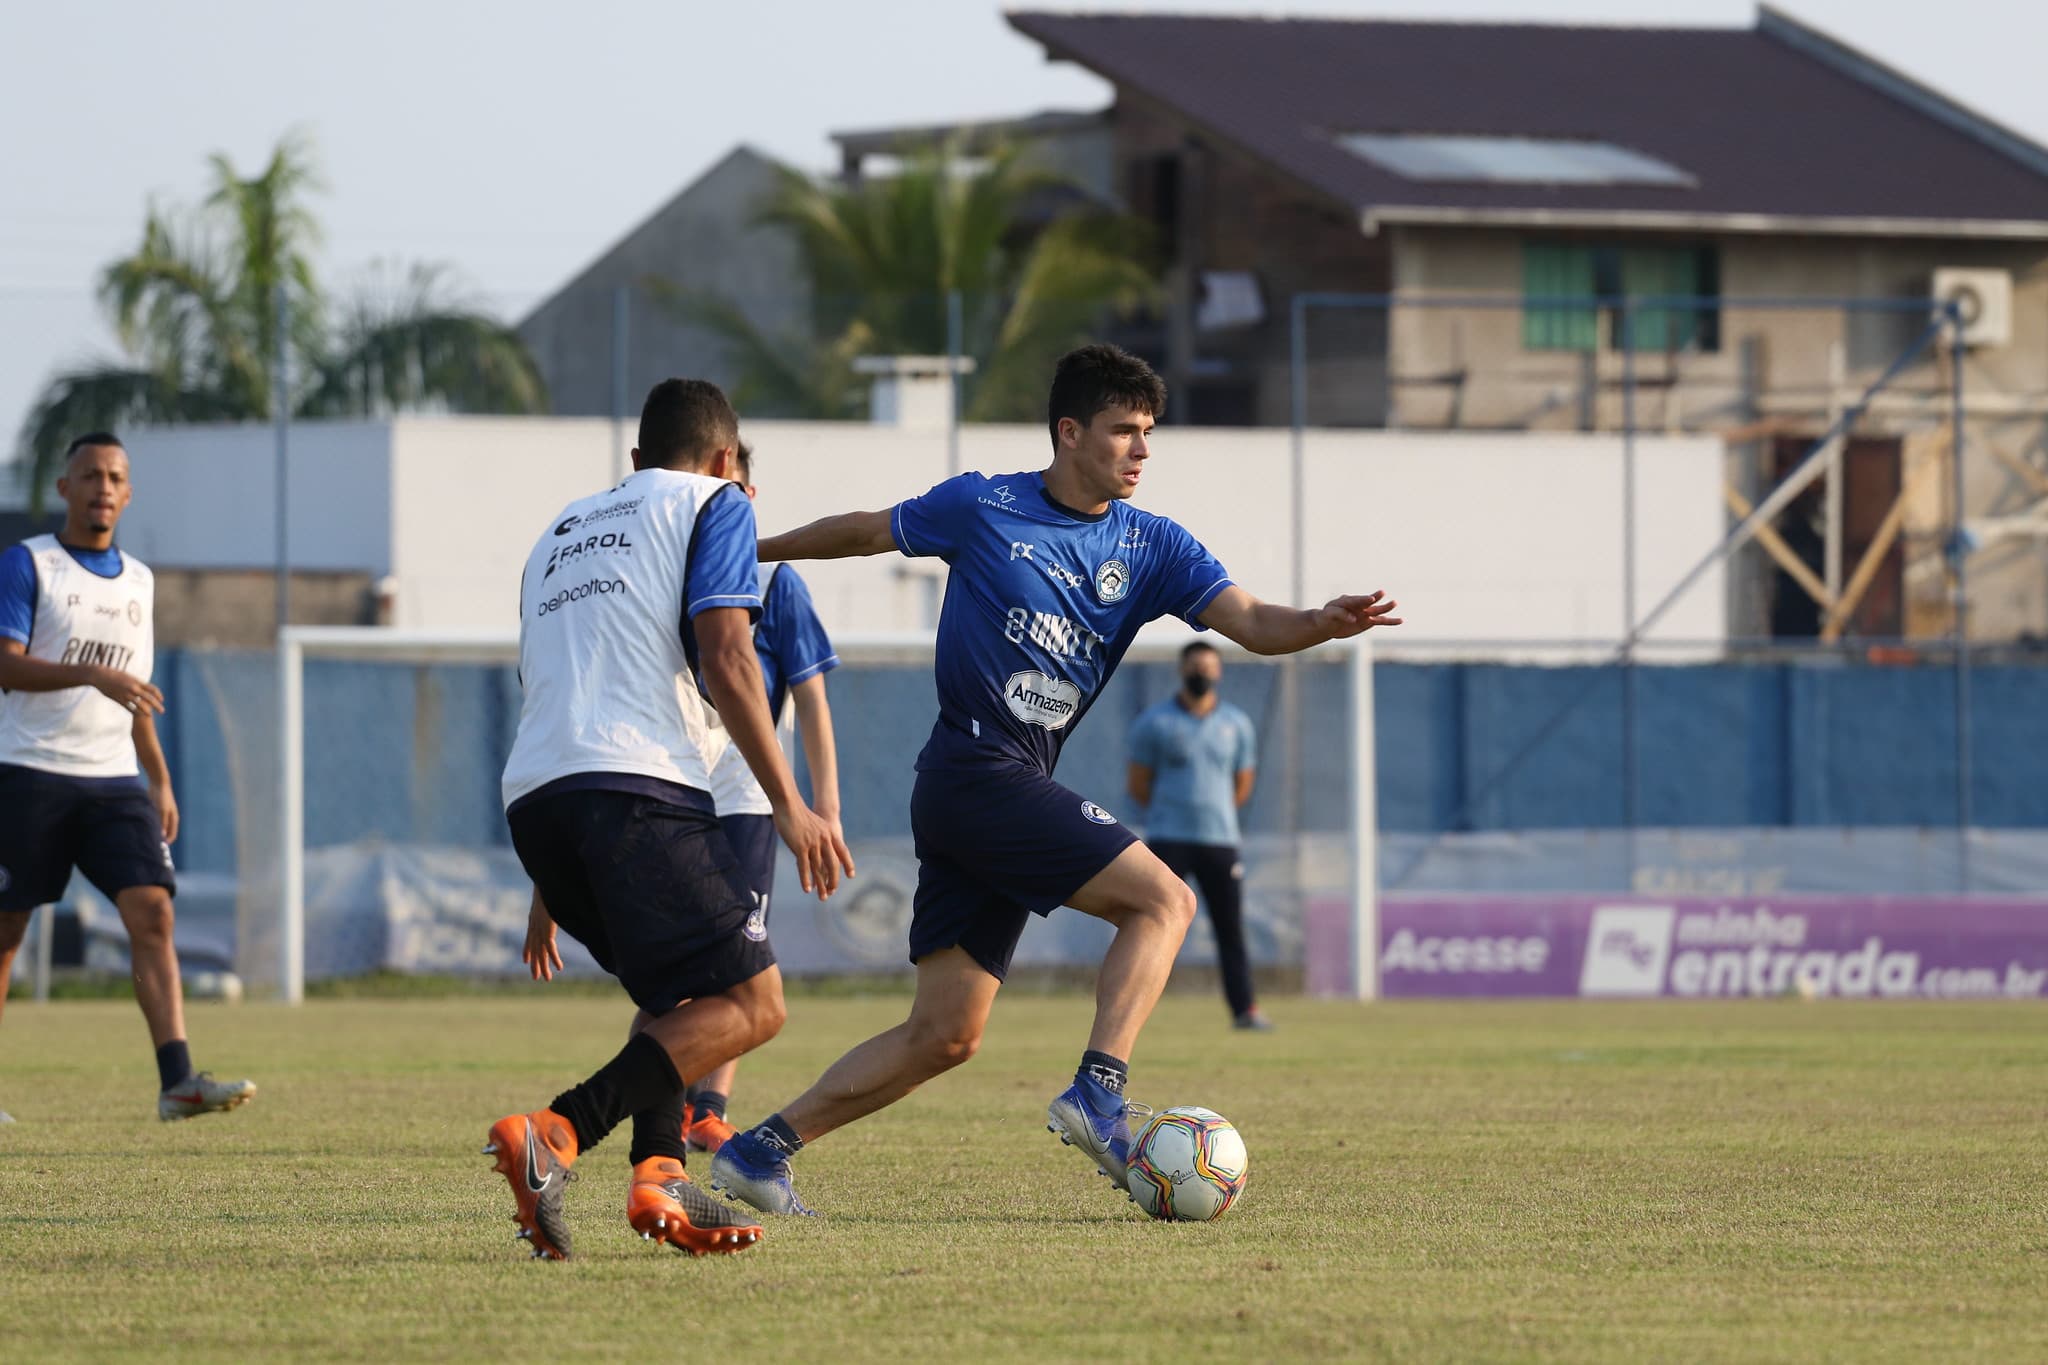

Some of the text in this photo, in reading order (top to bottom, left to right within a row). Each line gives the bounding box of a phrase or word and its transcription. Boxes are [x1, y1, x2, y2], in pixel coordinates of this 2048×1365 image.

[560, 533, 632, 561] FAROL
[1677, 905, 1807, 947] minha
[1382, 928, 1550, 974] Acesse
